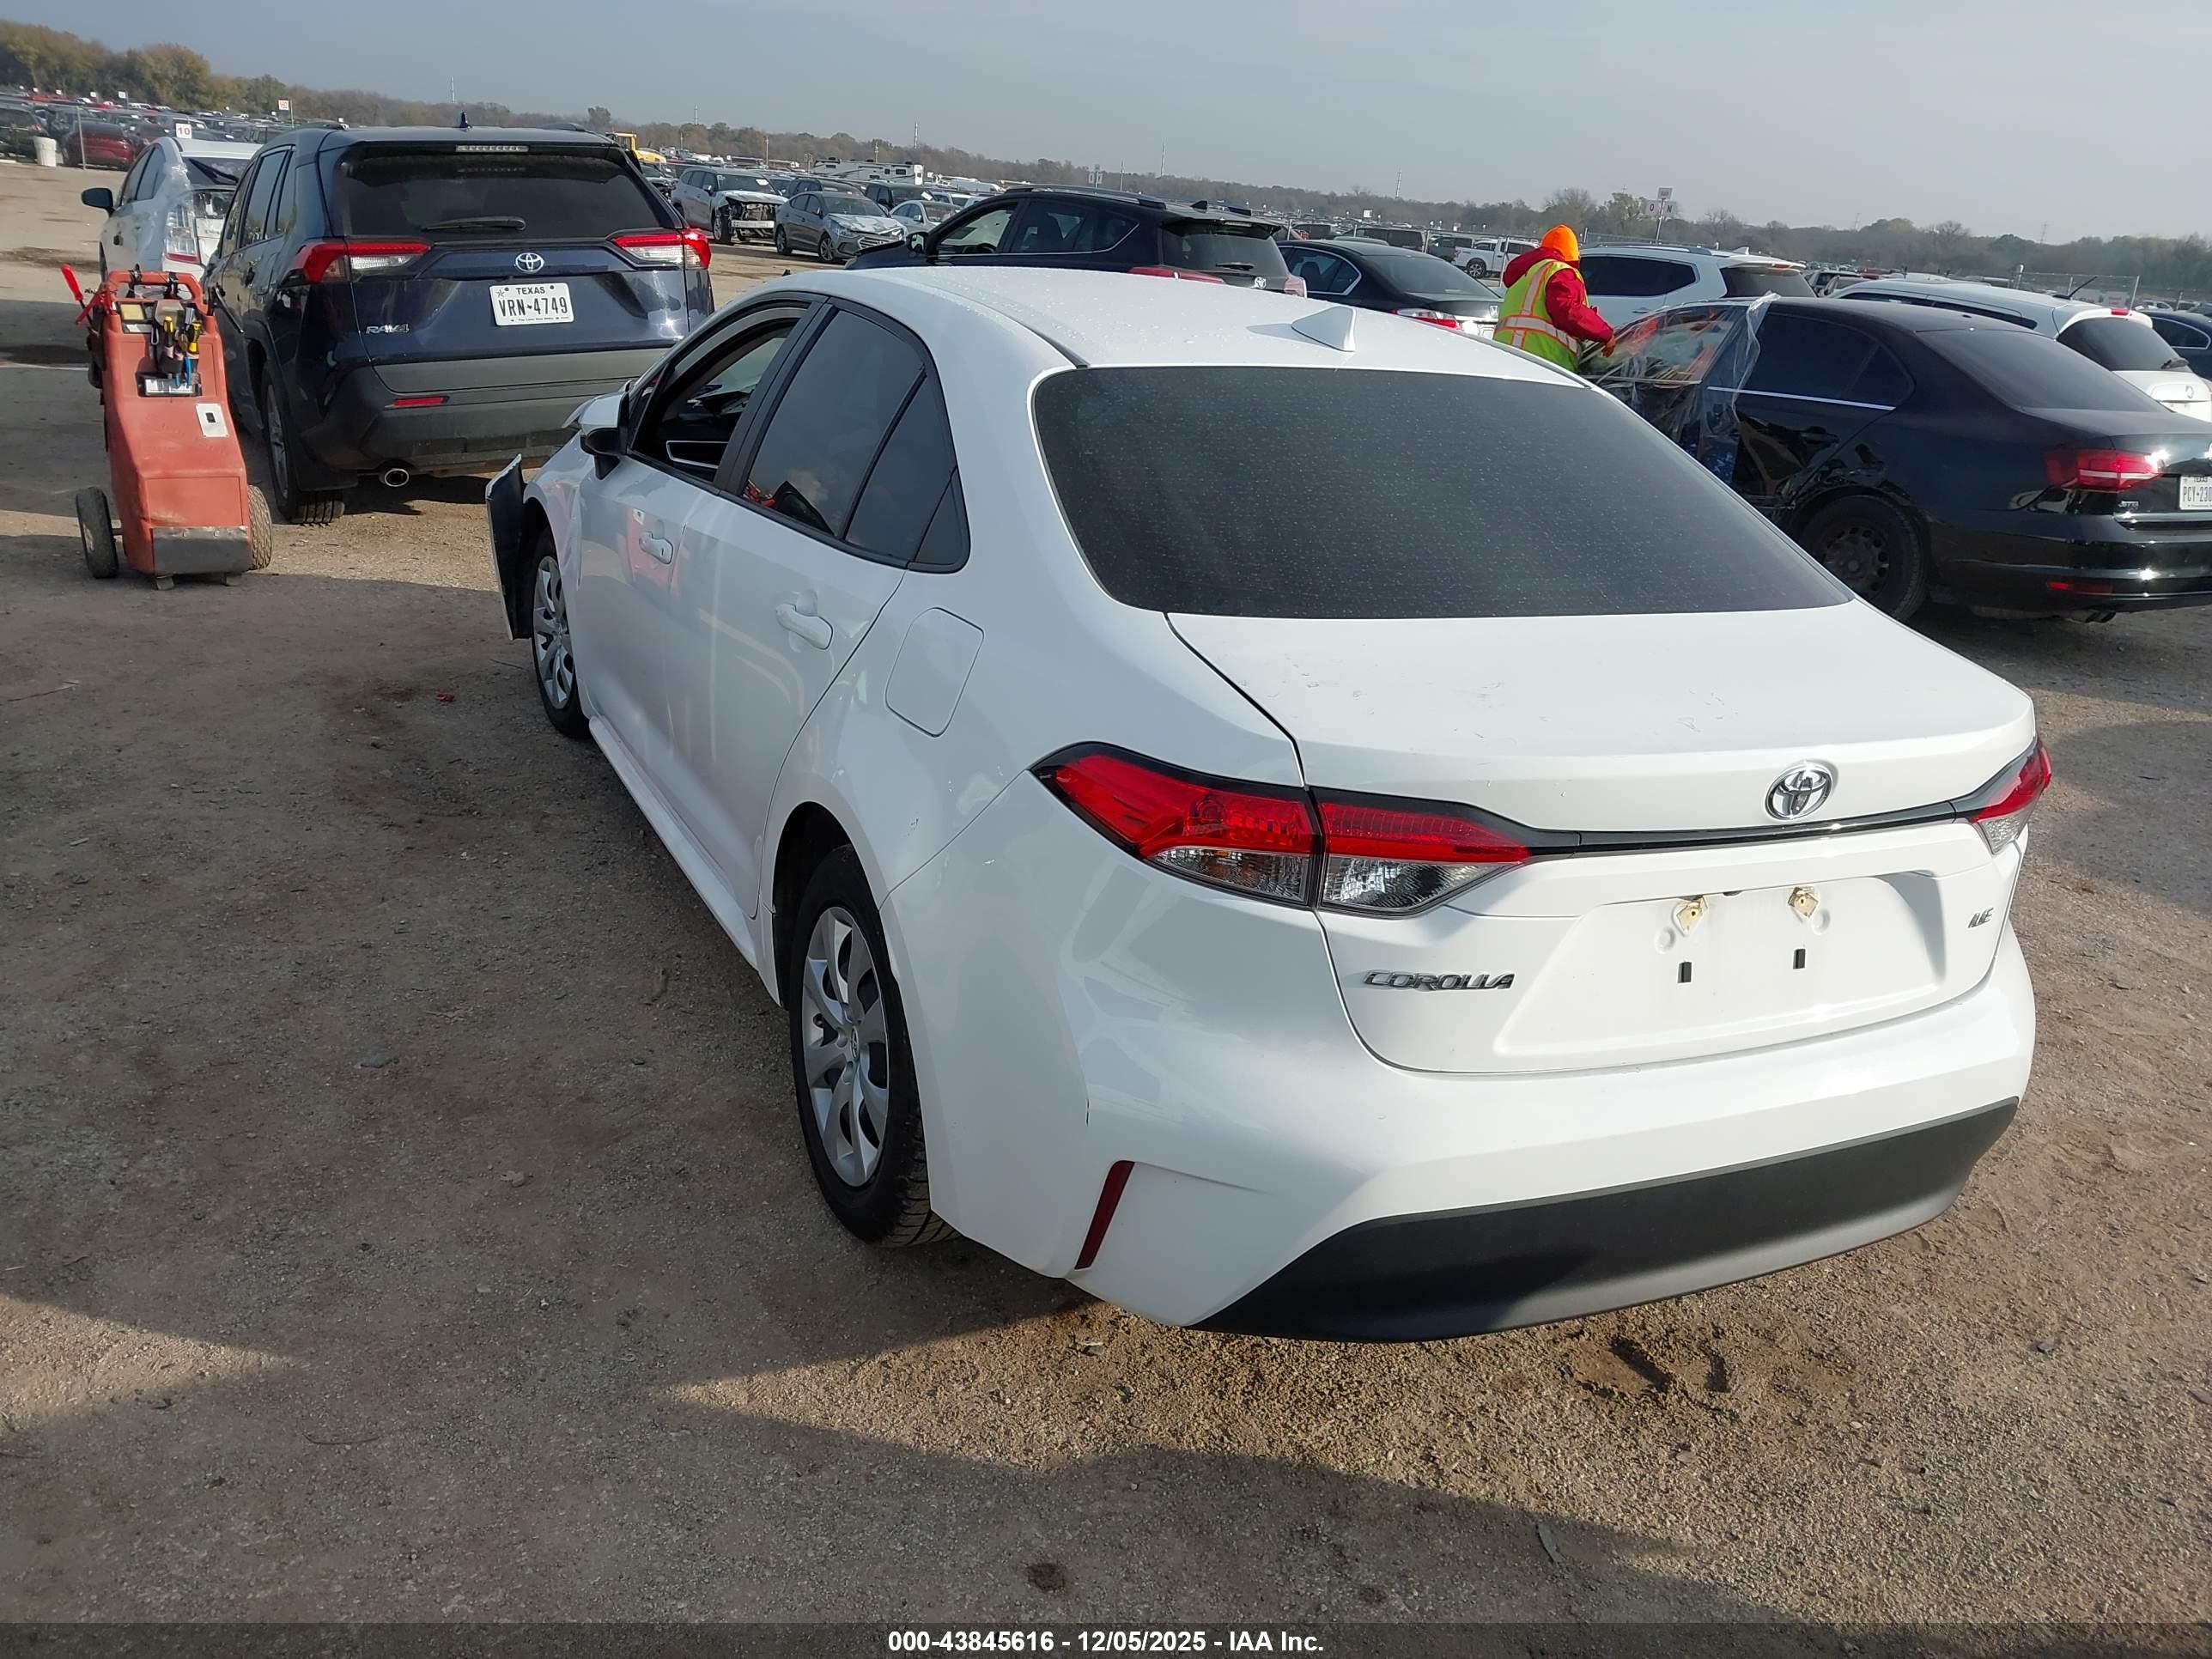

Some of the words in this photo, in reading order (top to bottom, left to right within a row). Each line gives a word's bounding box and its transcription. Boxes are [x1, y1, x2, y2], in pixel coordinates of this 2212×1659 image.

[178, 127, 191, 136] 10
[515, 286, 546, 295] TEXAS
[366, 323, 410, 334] RAV4
[1967, 907, 1994, 928] LE
[1363, 970, 1515, 991] COROLLA
